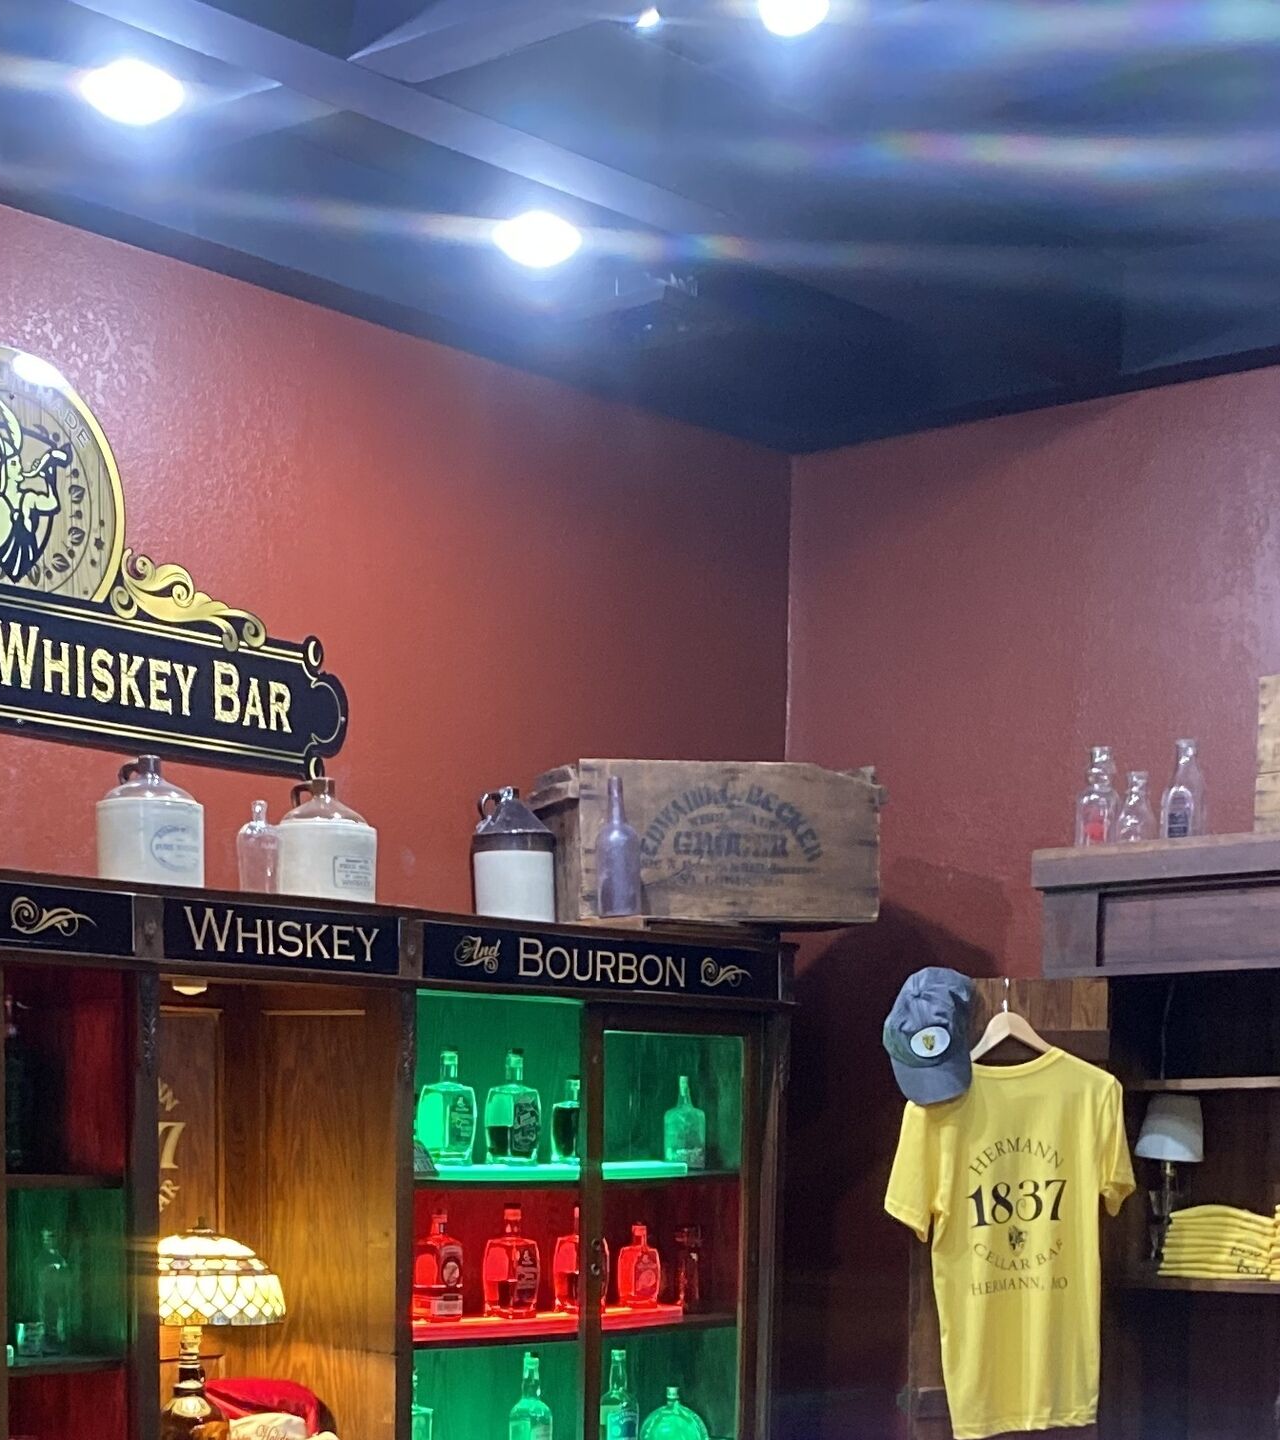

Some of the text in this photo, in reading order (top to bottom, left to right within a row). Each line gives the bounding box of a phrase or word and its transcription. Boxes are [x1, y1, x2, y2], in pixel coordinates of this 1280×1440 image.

[213, 660, 293, 735] BAR
[183, 903, 382, 964] WHISKEY
[518, 936, 687, 989] BOURBON
[969, 1136, 1064, 1176] HERMANN
[966, 1179, 1067, 1228] 1837
[973, 1242, 1031, 1271] CELLAR
